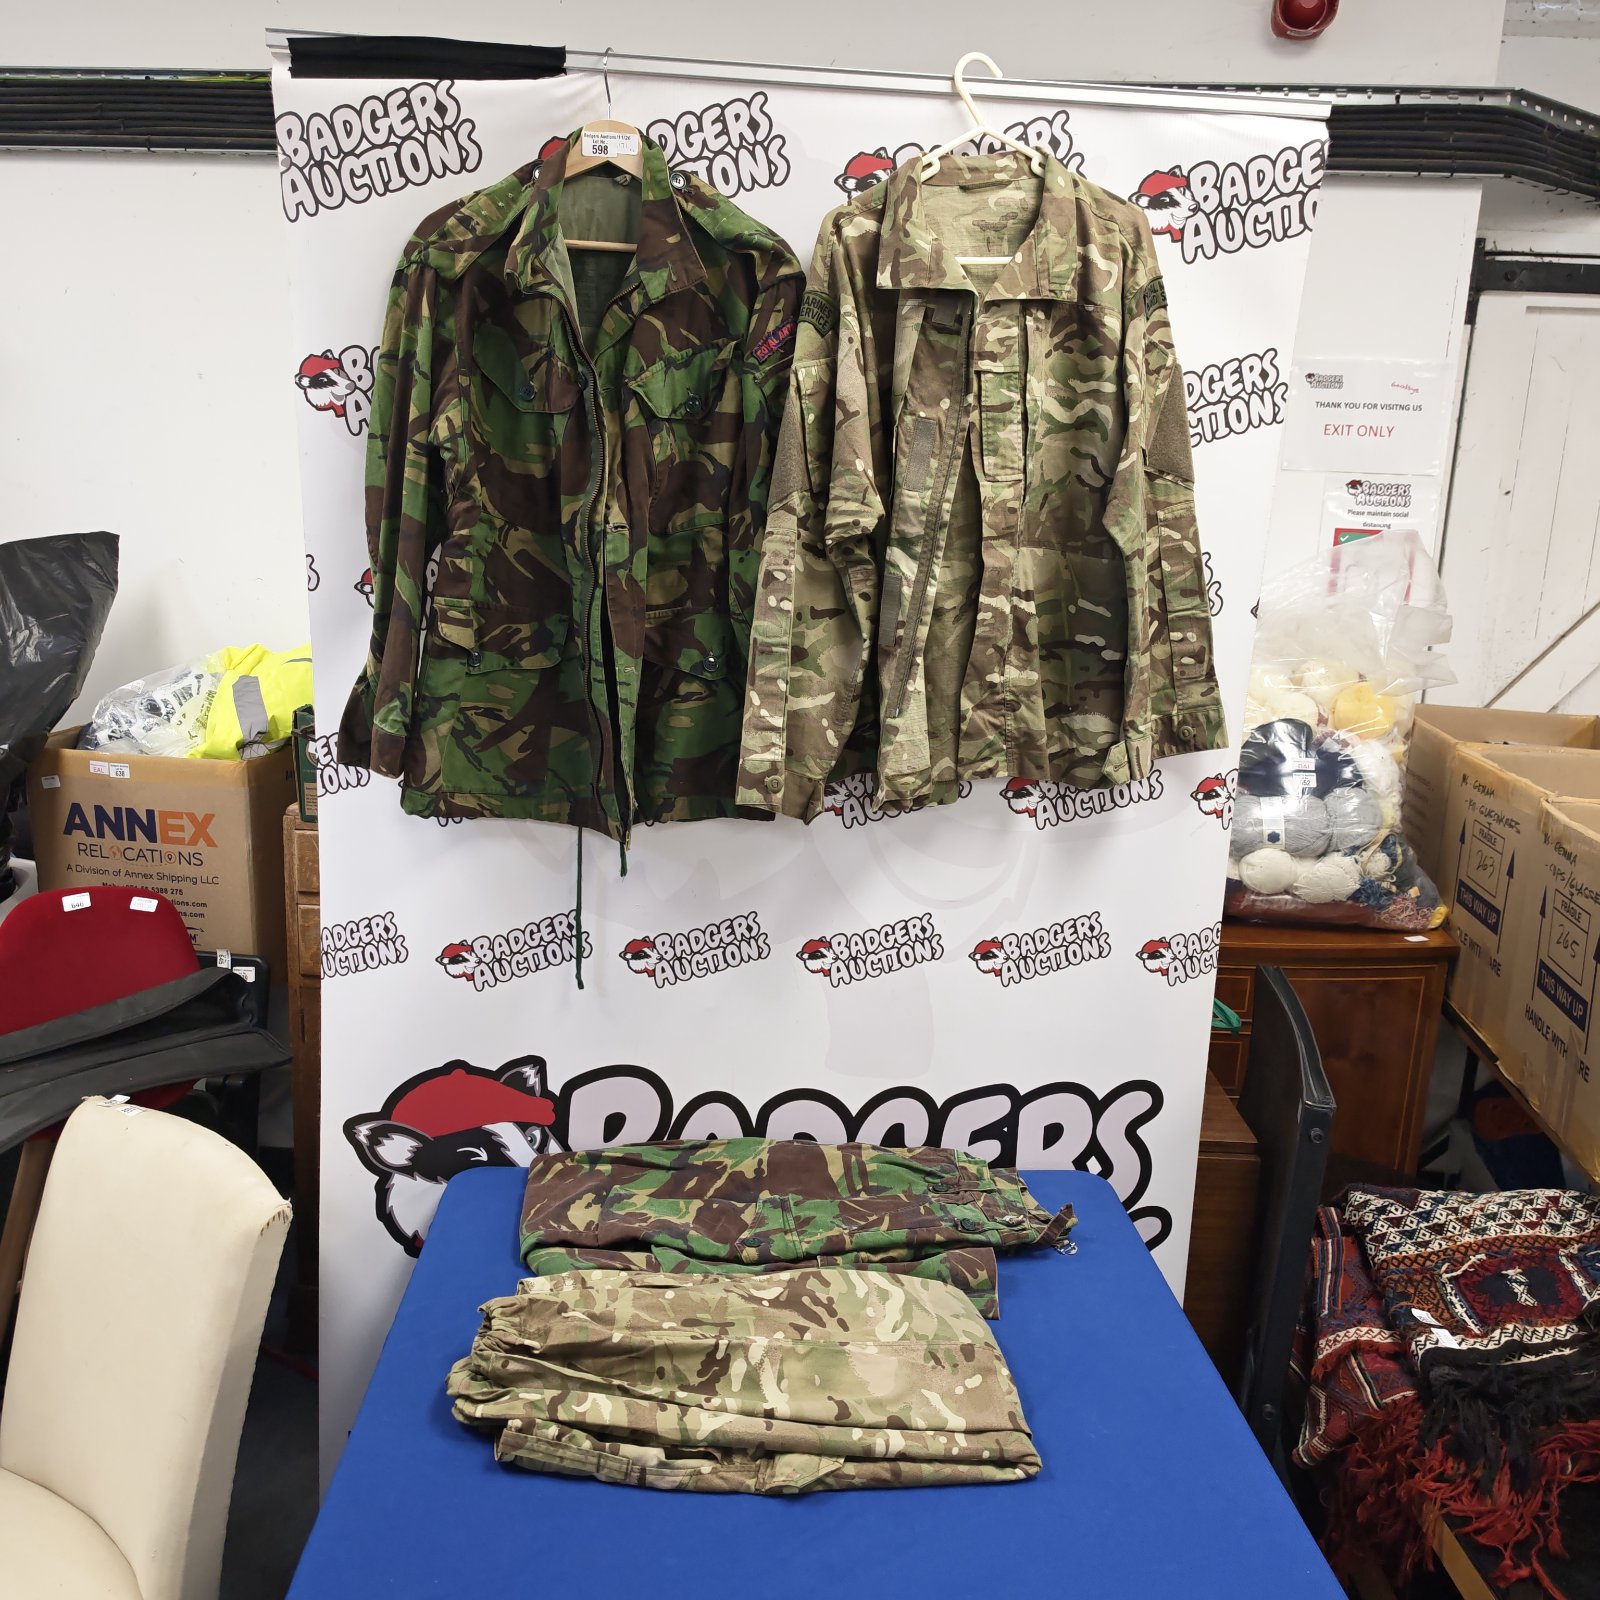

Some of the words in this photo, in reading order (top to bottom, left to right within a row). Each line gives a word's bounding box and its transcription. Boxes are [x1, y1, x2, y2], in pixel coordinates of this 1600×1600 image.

[275, 79, 461, 167] BADGERS
[646, 91, 773, 163] DGERS
[281, 118, 482, 222] AUCTIONS
[592, 144, 609, 155] 598
[1188, 138, 1327, 215] BADGE
[799, 306, 830, 330] ERVICE
[1183, 347, 1280, 411] DGERS
[1315, 401, 1342, 409] THANK
[1344, 402, 1361, 410] YOU
[1363, 402, 1378, 410] FOR
[1412, 404, 1423, 412] US
[1323, 423, 1353, 437] EXIT
[1357, 424, 1395, 438] ONLY
[1355, 493, 1411, 508] AUCTIONS
[1361, 480, 1411, 496] BADGERS
[1034, 769, 1164, 830] AUCTIONS
[63, 802, 218, 848] ANNEX
[66, 863, 74, 872] A
[75, 864, 109, 876] Division
[112, 868, 122, 877] of
[124, 869, 154, 881] Annex
[156, 872, 197, 885] Shipping
[200, 875, 220, 885] LLC
[170, 888, 184, 896] 275
[1460, 887, 1473, 908] THIS
[1473, 899, 1488, 920] WAY
[1487, 908, 1498, 926] UP
[1560, 899, 1582, 924] FRAGILE
[321, 911, 397, 952] ADGERS
[653, 911, 761, 961] BADGERS
[829, 912, 935, 961] BADGERS
[1001, 911, 1103, 960] BADGERS
[321, 934, 409, 980] UCTIONS
[654, 932, 771, 989] AUCTIONS
[829, 933, 945, 988] AUCTIONS
[1000, 931, 1112, 987] AUCTIONS
[1539, 968, 1556, 995] THIS
[1556, 983, 1573, 1010] WAY
[1572, 1000, 1584, 1022] UP
[1524, 1004, 1551, 1041] HANDLE
